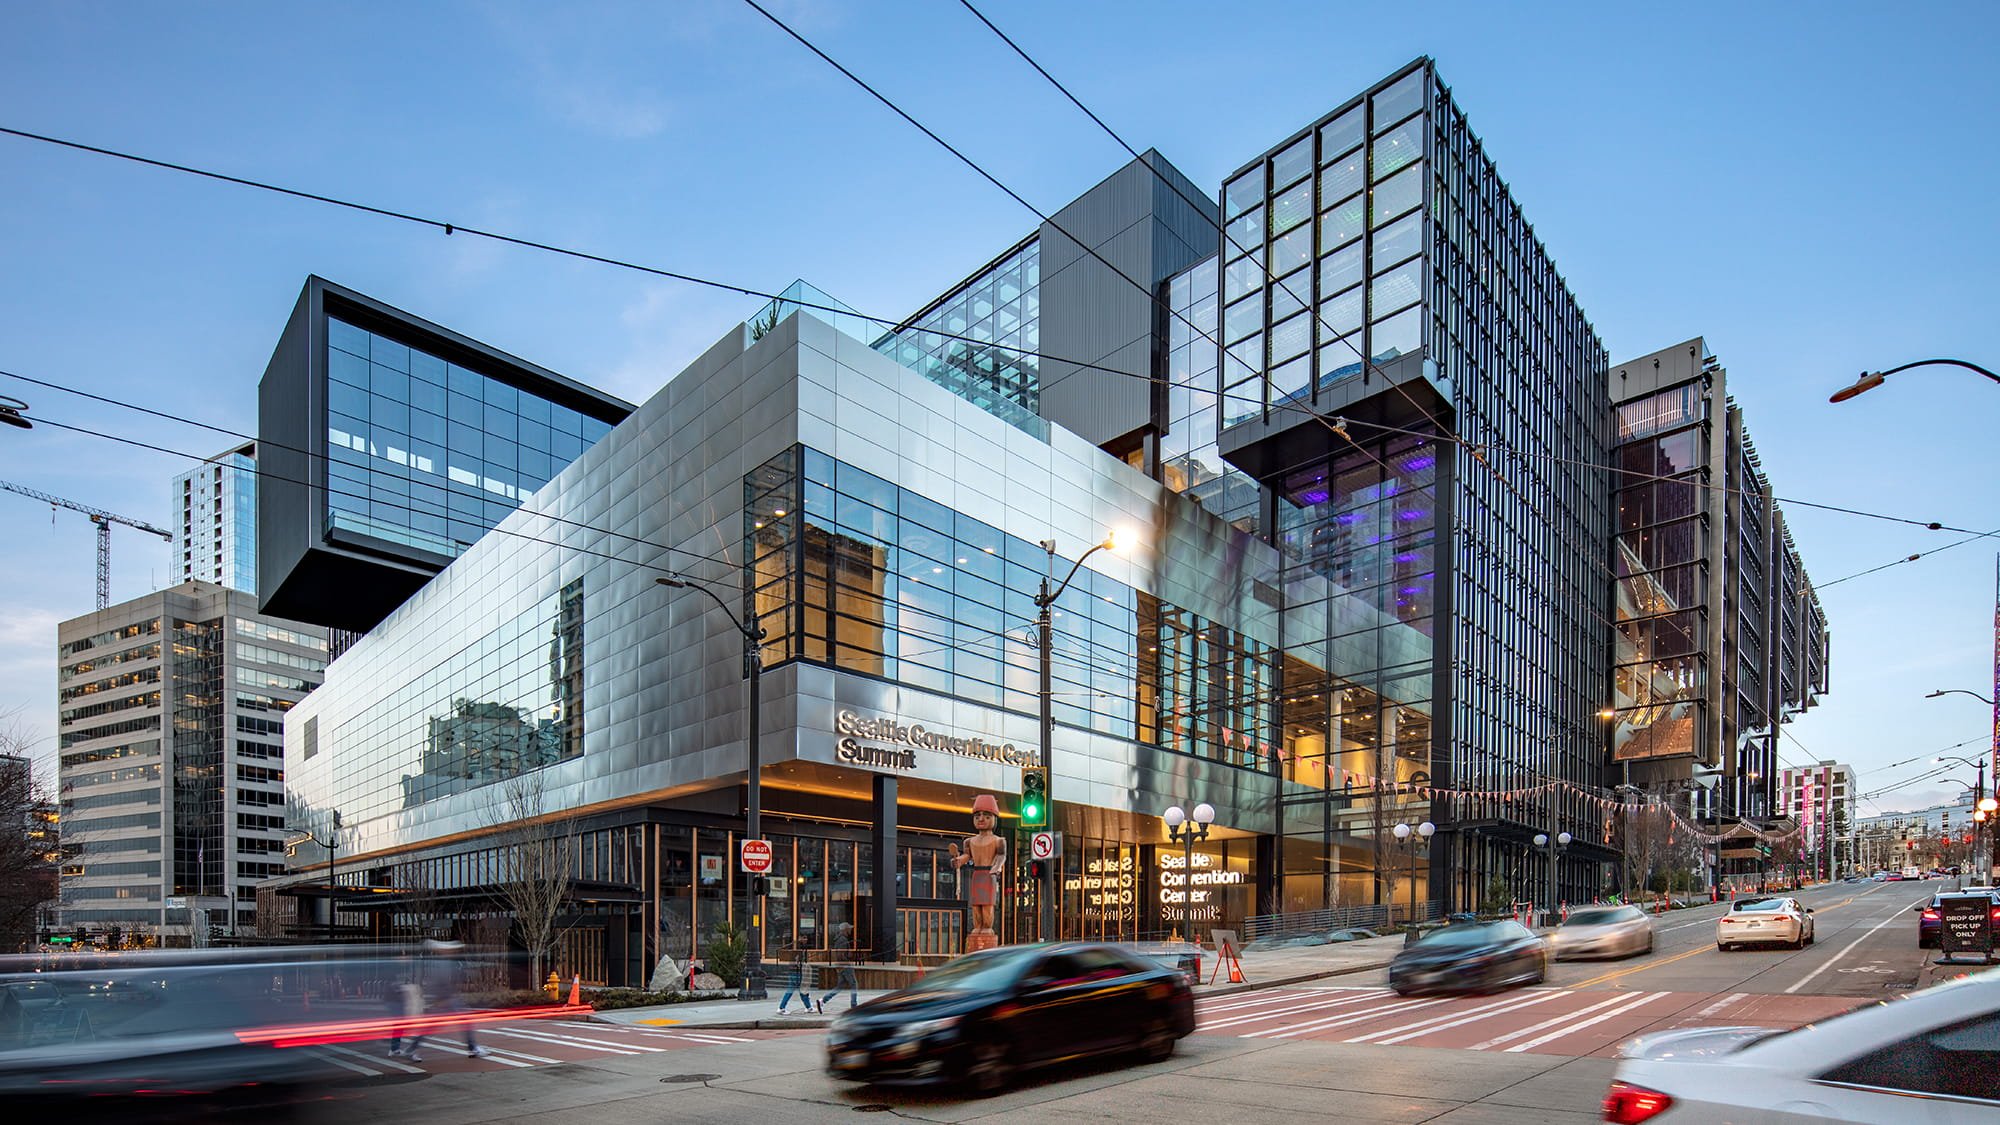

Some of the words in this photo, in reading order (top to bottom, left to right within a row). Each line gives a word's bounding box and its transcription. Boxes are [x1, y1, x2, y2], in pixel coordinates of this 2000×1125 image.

[838, 709, 908, 744] Seattle
[907, 723, 1002, 763] Convention
[1000, 742, 1041, 769] Cent
[838, 736, 917, 770] Summit
[1160, 852, 1210, 869] Seatle
[1160, 888, 1209, 903] Cener
